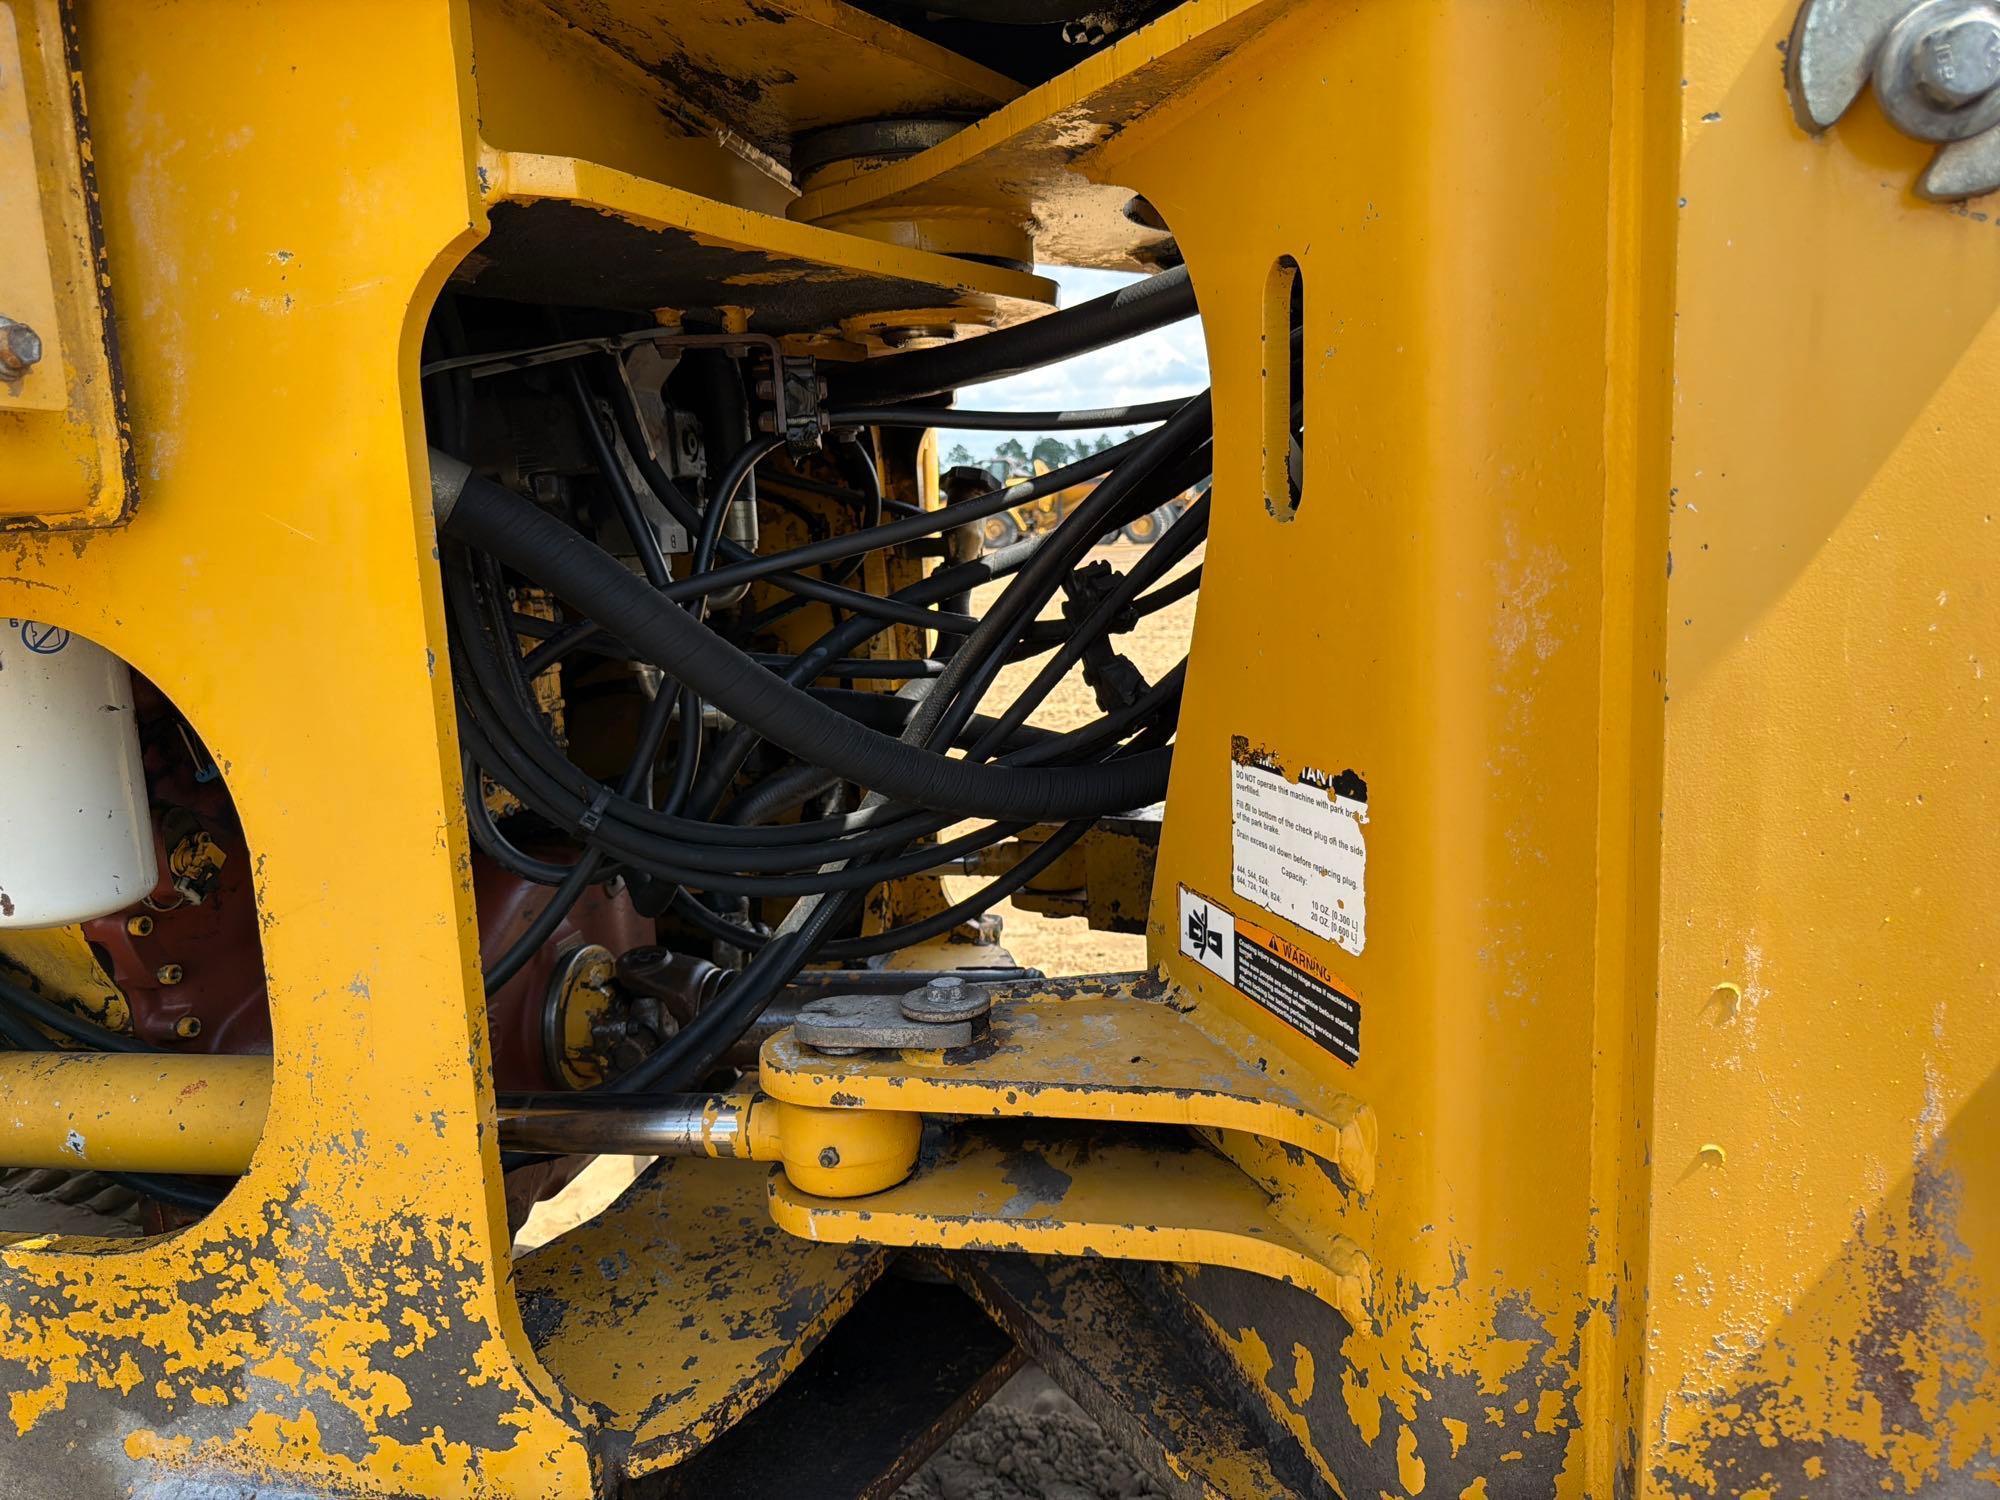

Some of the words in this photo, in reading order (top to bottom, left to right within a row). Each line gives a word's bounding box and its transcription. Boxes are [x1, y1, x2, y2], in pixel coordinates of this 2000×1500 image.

[1236, 783, 1260, 797] overfilled.
[1236, 770, 1244, 779] DO
[1245, 773, 1256, 783] NOT
[1257, 779, 1277, 792] operate
[1278, 785, 1289, 796] this
[1290, 791, 1314, 805] machine
[1316, 799, 1329, 810] with
[1330, 804, 1344, 815] park
[1236, 811, 1242, 820] of
[1242, 813, 1250, 824] the
[1251, 818, 1262, 828] park
[1264, 823, 1280, 836] brake.
[1252, 805, 1258, 815] to
[1258, 808, 1277, 822] bottom
[1278, 816, 1285, 825] of
[1285, 818, 1295, 828] the
[1296, 824, 1313, 836] check
[1314, 831, 1327, 844] plug
[1339, 840, 1348, 850] the
[1350, 845, 1364, 856] side
[1236, 828, 1249, 840] Drain
[1250, 836, 1267, 850] excess
[1277, 847, 1292, 860] down
[1293, 853, 1312, 868] before
[1342, 876, 1358, 890] plug.
[1281, 866, 1308, 886] Capacity:
[1311, 911, 1318, 922] 20
[1319, 916, 1330, 928] OZ.
[1351, 931, 1358, 944] L]
[1312, 900, 1319, 911] 10
[1320, 905, 1330, 916] OZ.
[1332, 910, 1350, 926] [0.300
[1352, 919, 1358, 932] L]
[1283, 942, 1331, 982] WARNING
[1239, 955, 1250, 968] Make
[1260, 970, 1274, 983] people
[1274, 979, 1282, 988] are
[1282, 984, 1293, 994] clear
[1299, 994, 1319, 1011] machine
[1319, 1005, 1334, 1020] before
[1334, 1017, 1354, 1035] starting
[1258, 976, 1274, 992] moving
[1327, 992, 1347, 1009] machine
[1347, 1003, 1353, 1012] is
[1275, 997, 1290, 1012] before
[1315, 1024, 1333, 1040] service
[1333, 1036, 1344, 1048] near
